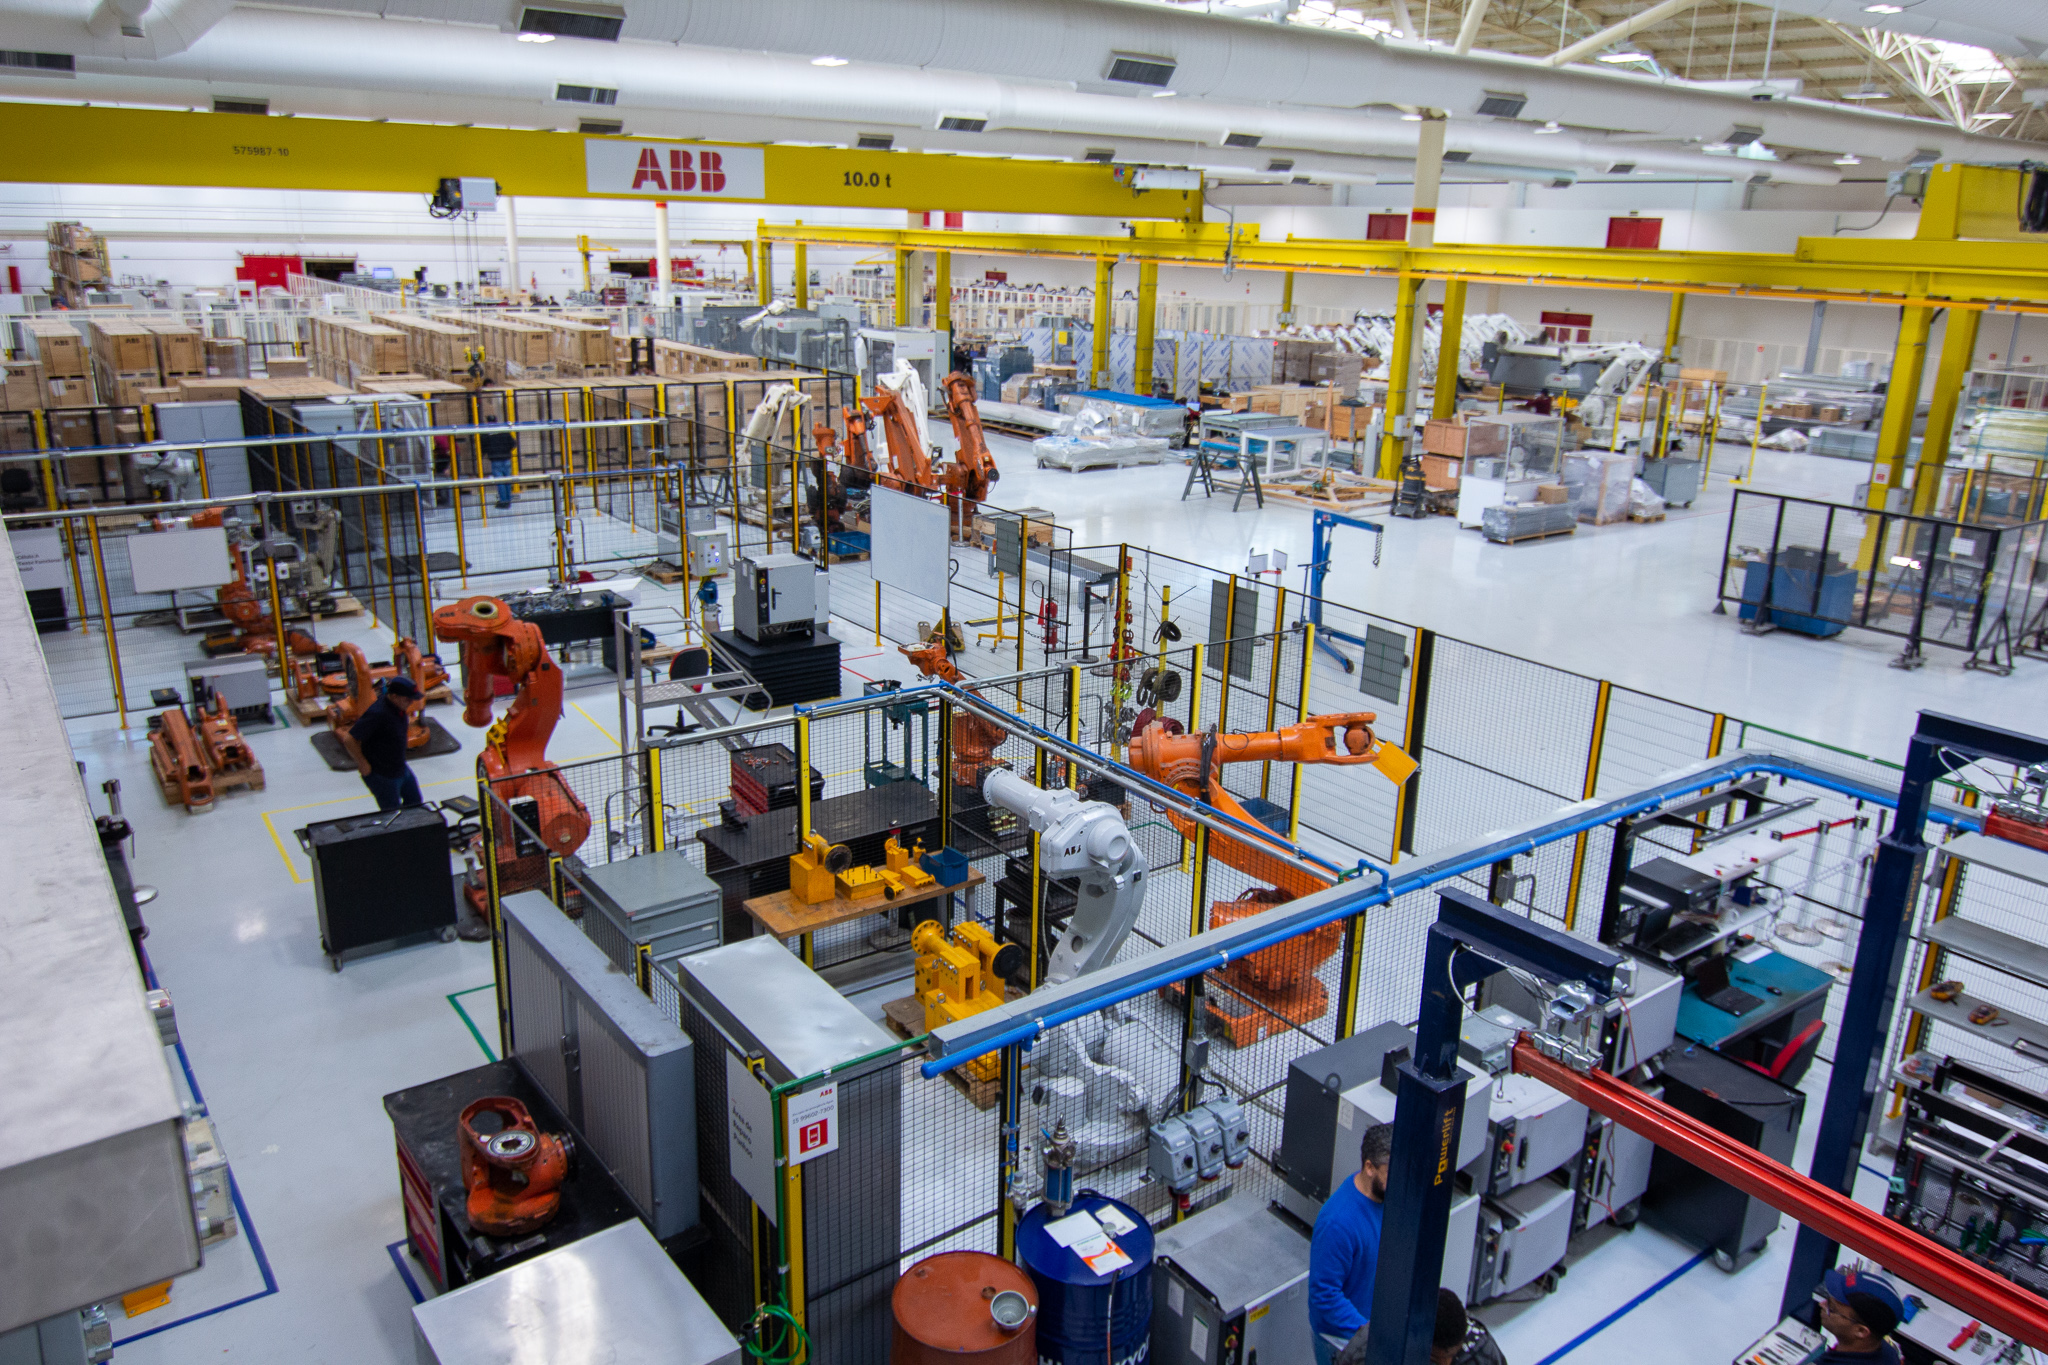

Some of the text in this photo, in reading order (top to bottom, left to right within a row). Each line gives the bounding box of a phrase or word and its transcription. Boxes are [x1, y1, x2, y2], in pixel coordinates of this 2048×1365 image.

[233, 145, 290, 157] 575987-10
[631, 147, 727, 193] ABB
[843, 171, 892, 188] 10.0 t
[820, 1089, 833, 1097] ABB
